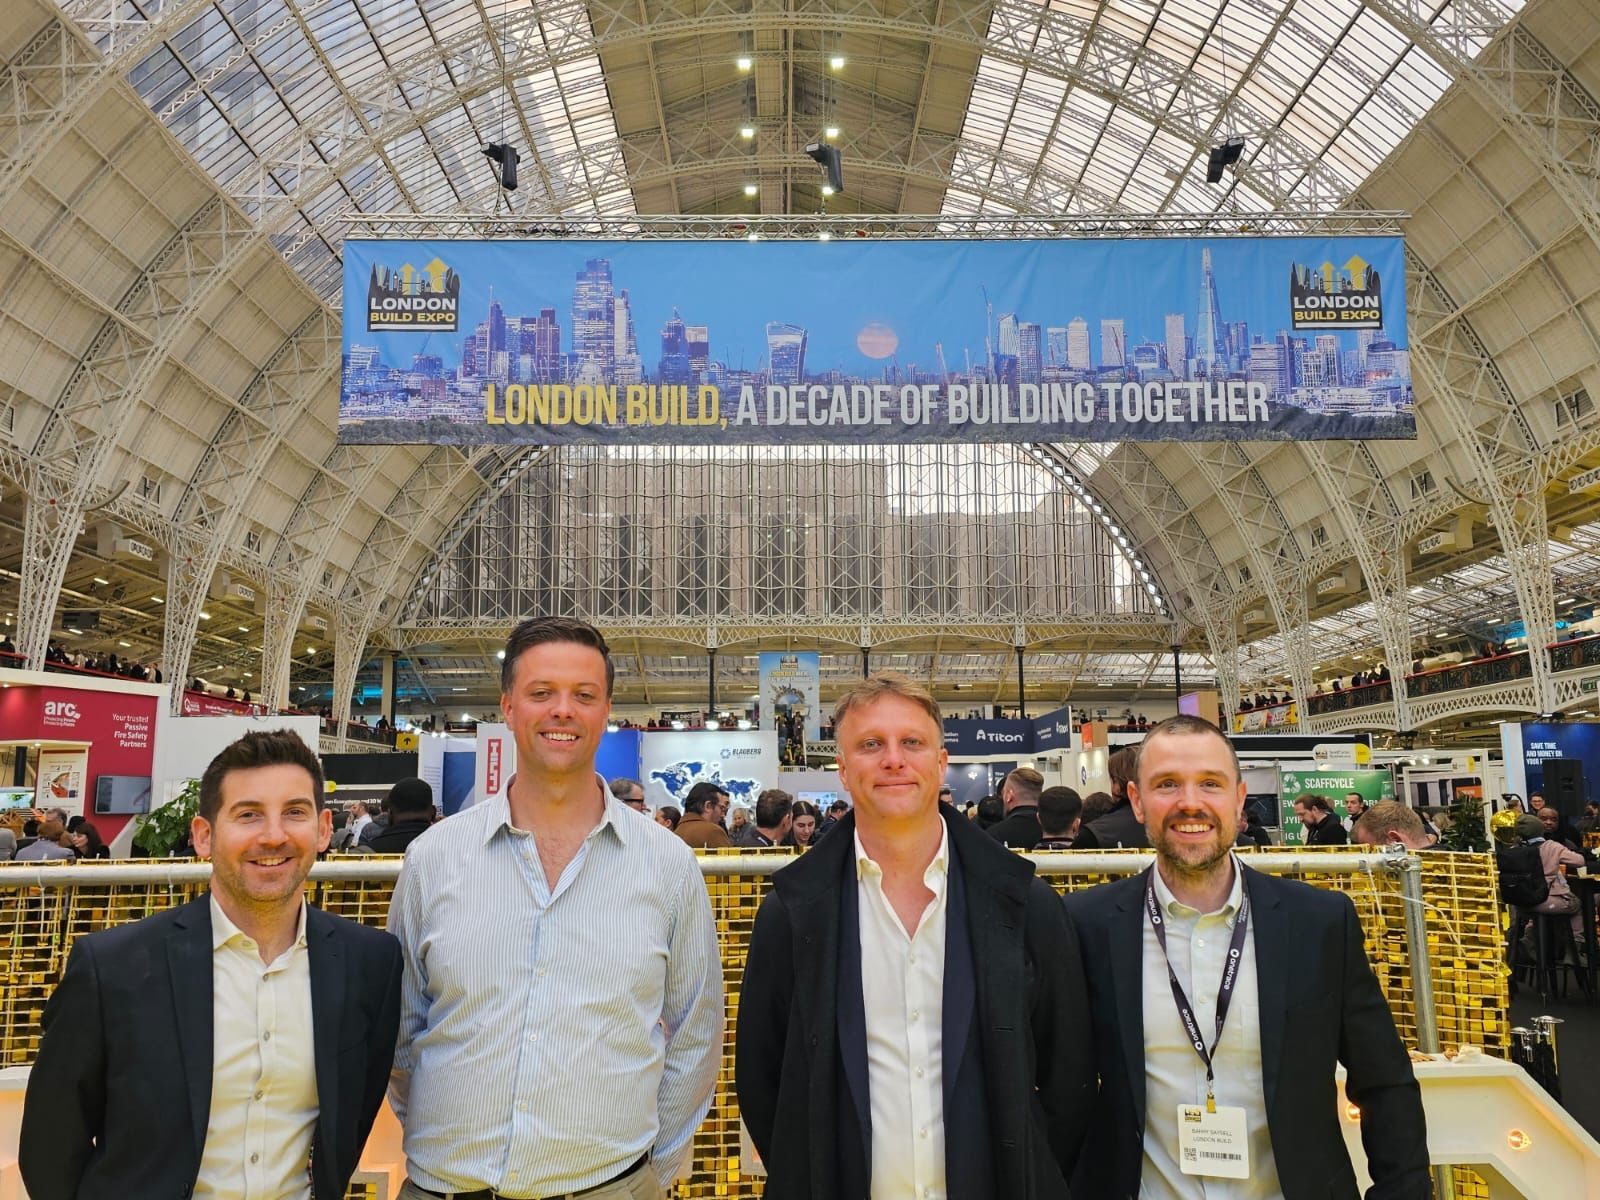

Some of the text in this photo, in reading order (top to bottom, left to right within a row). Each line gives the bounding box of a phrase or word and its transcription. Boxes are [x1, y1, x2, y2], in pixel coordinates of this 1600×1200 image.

[370, 297, 456, 310] LONDON
[1293, 295, 1379, 309] LONDON
[370, 312, 456, 322] BUILD EXPO
[1294, 310, 1380, 321] BUILD EXPO
[486, 381, 1269, 431] LONDON BUILD, A DECADE OF BUILDING TOGETHER
[112, 713, 126, 721] Your
[125, 723, 148, 731] Passive
[114, 731, 147, 741] Fire Safety
[987, 733, 1023, 742] Titon
[120, 740, 147, 748] Partners
[1530, 742, 1557, 750] SAVE TIME
[1526, 750, 1563, 758] AND MONEY ON
[488, 741, 500, 792] HILTI
[1305, 778, 1355, 788] SCAFFCYCLE
[1224, 958, 1238, 990] onetrace
[1182, 1008, 1200, 1043] onetrace
